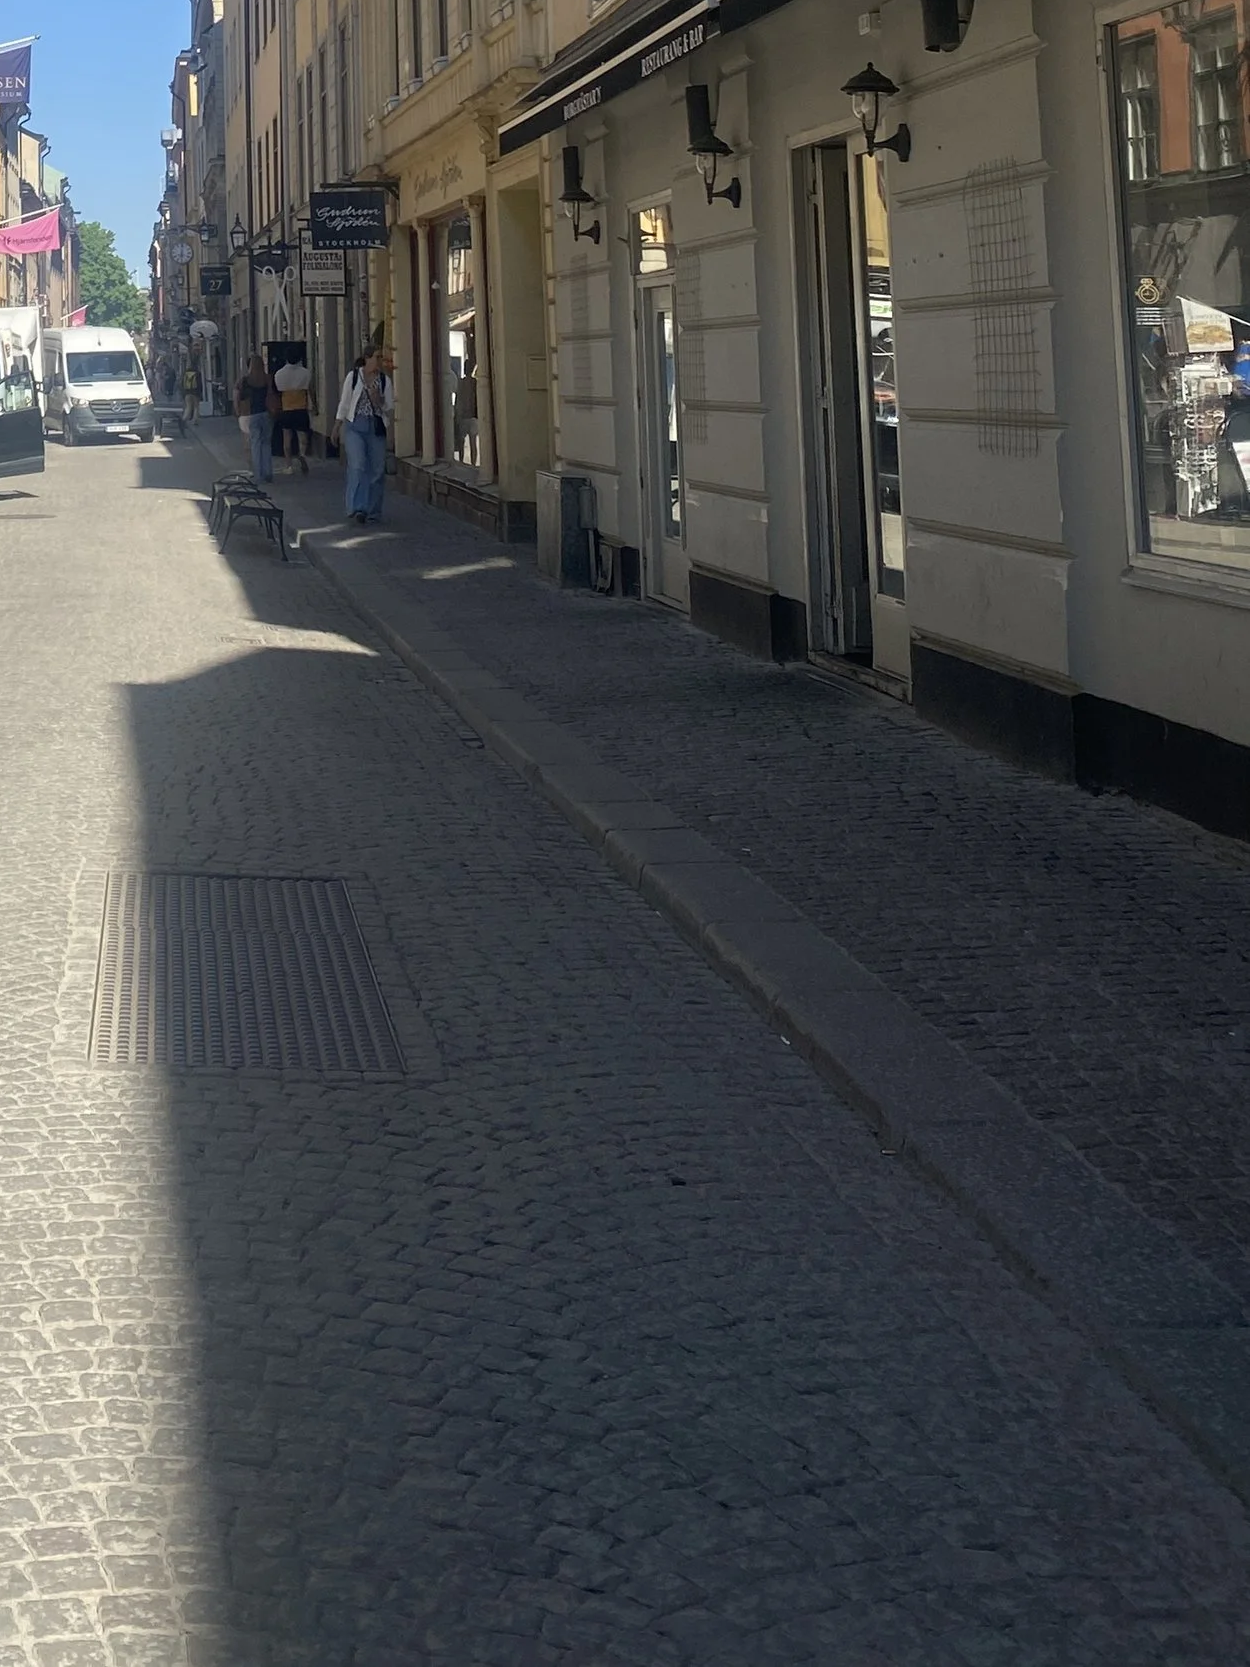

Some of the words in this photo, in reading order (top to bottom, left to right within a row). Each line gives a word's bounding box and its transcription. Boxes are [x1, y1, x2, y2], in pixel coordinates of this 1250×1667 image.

[641, 36, 683, 78] RESTAURANG
[689, 25, 704, 50] BAR
[315, 206, 382, 221] Gudrun
[318, 239, 381, 247] STOCKHOLM
